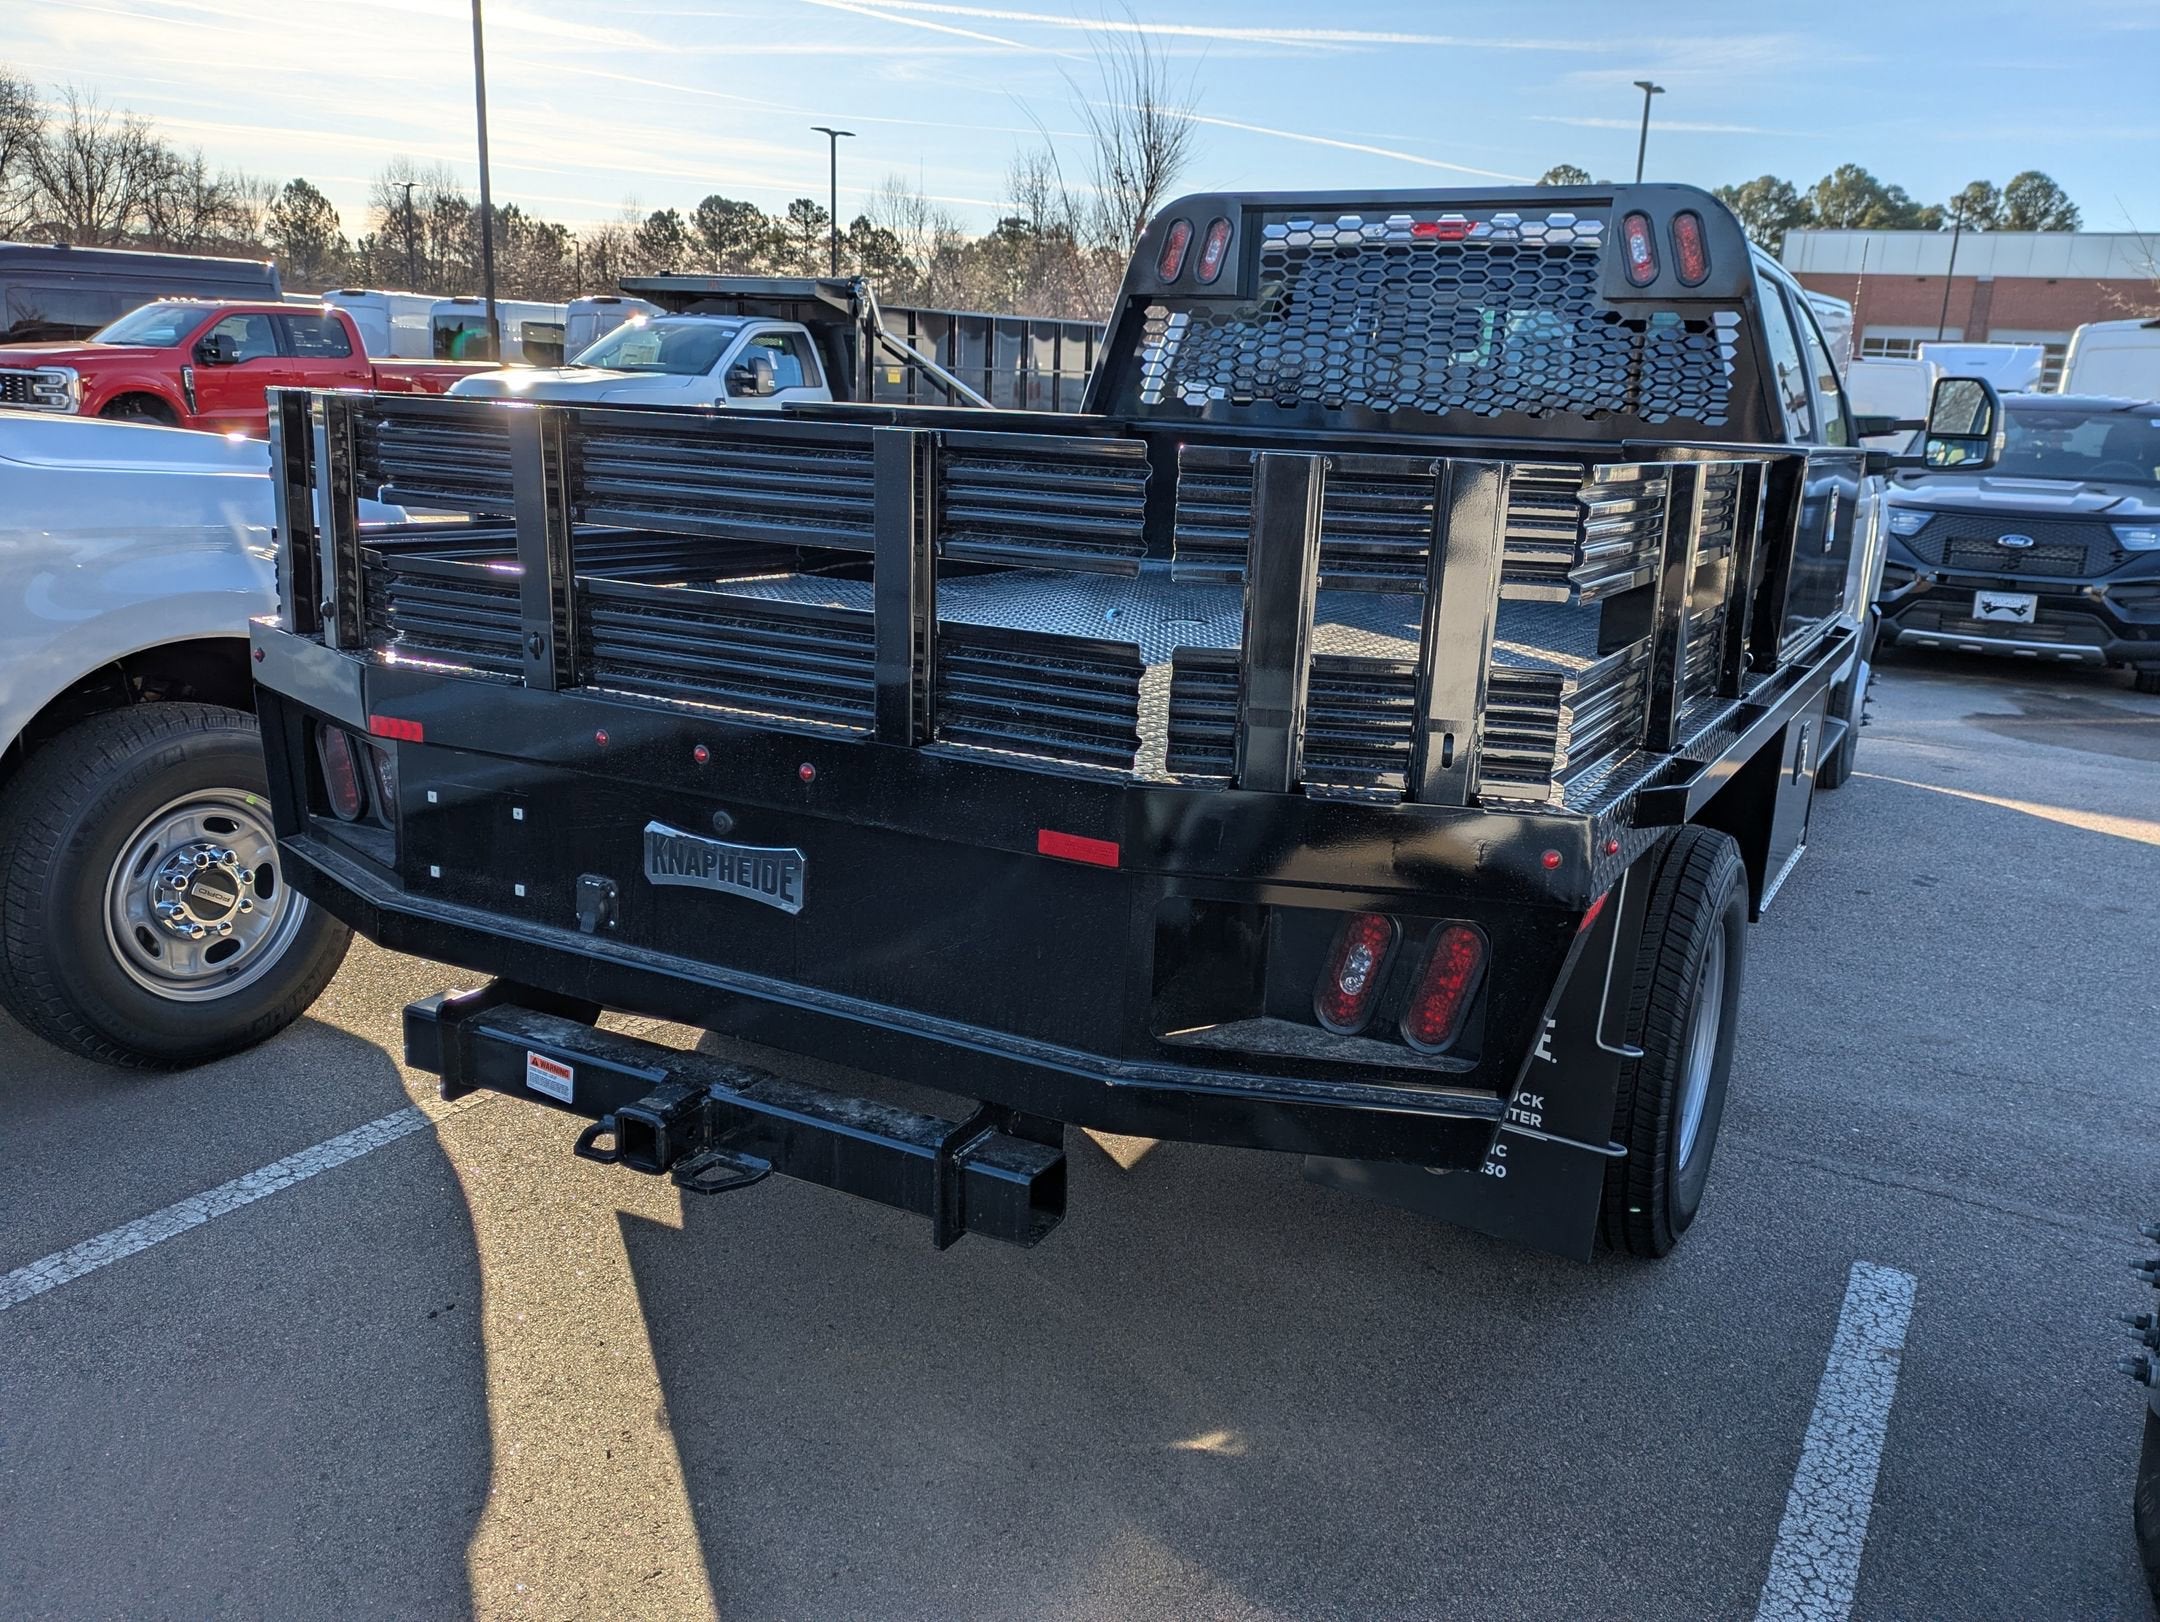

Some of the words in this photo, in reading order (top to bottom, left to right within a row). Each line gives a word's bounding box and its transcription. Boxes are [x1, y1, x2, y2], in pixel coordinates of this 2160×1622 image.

[651, 832, 796, 903] KNAPHEIDE
[198, 887, 231, 903] FORD
[539, 1059, 569, 1079] WARNING
